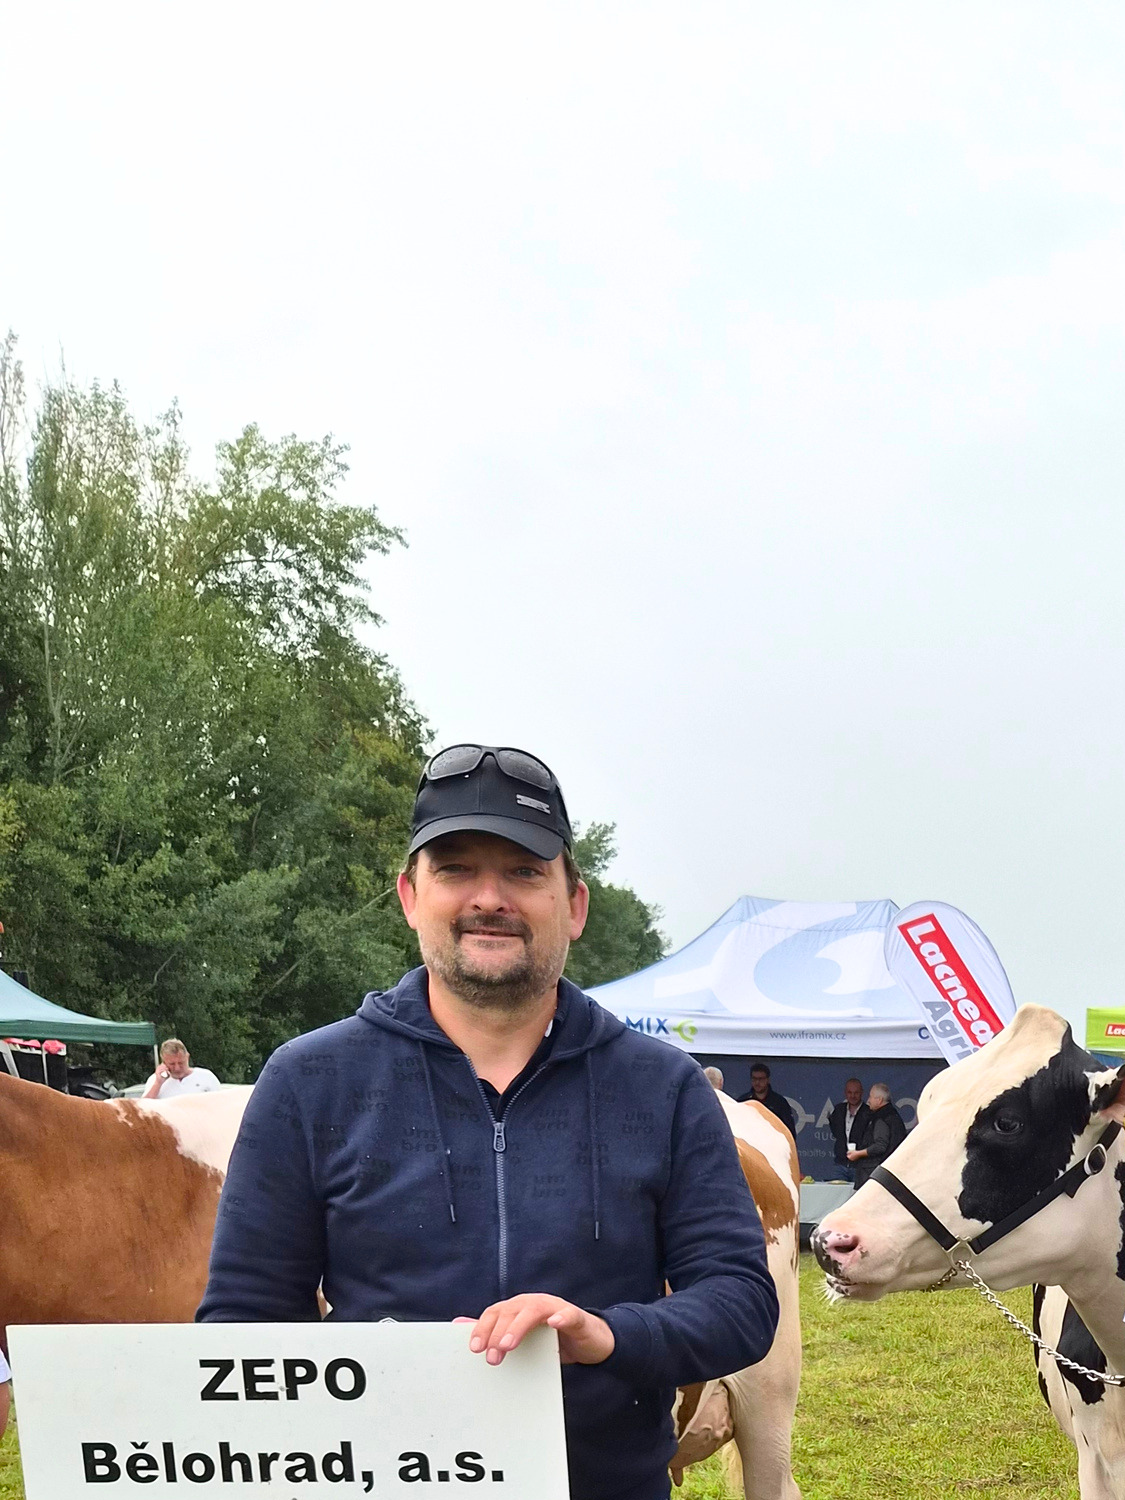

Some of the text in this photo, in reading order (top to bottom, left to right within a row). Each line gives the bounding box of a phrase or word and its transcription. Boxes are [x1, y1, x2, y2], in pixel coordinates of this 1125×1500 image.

[907, 920, 995, 1045] Lacnea
[621, 1016, 670, 1035] MIX
[769, 1031, 847, 1041] www.iframix.cz
[199, 1358, 367, 1402] ZEPO
[81, 1441, 505, 1493] Bělohrad, a.s.
